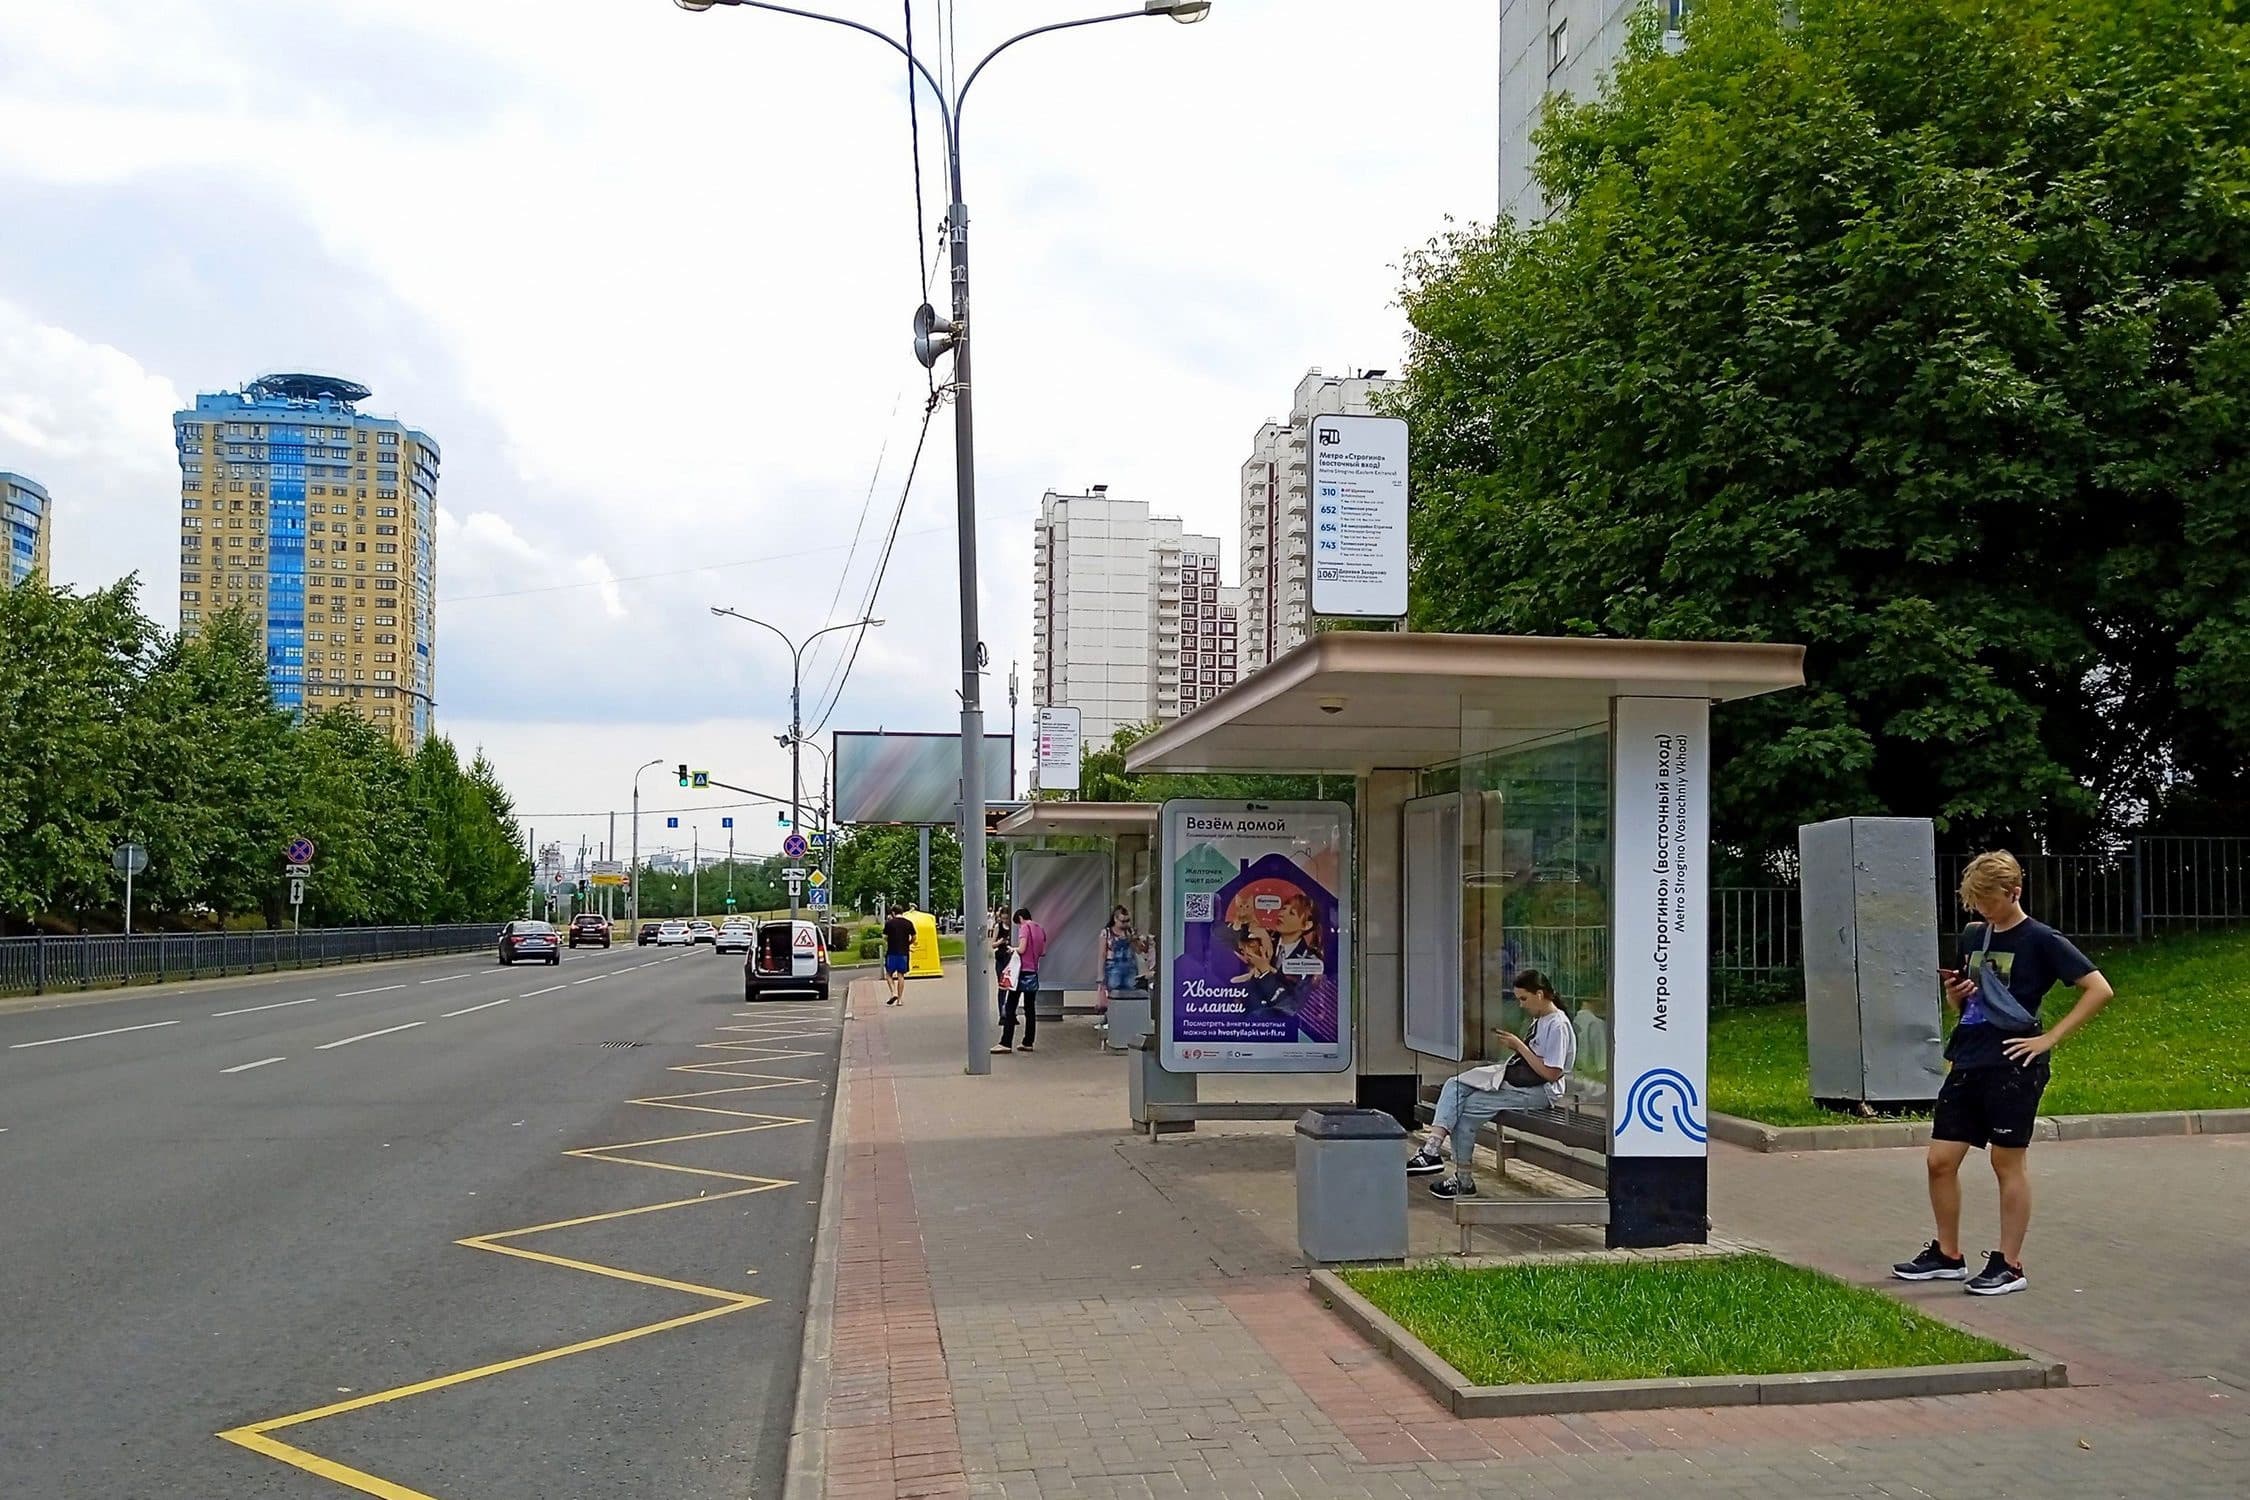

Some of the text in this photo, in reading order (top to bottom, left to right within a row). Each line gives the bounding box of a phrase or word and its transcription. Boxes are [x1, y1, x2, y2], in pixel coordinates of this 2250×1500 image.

[1319, 452, 1343, 460] Метро
[1322, 488, 1336, 496] 310
[1321, 506, 1336, 514] 652
[1321, 524, 1336, 532] 654
[1320, 541, 1336, 550] 743
[1318, 570, 1337, 578] 1067
[1187, 817, 1285, 832] Везём домой
[1674, 735, 1688, 932] Metro Strogino (Vostochniy Vkhod)
[1653, 734, 1672, 1032] Метро «Строгино» (восточный вход)
[1182, 979, 1249, 997] Хвосты
[1186, 1003, 1246, 1013] и лапки
[1183, 1020, 1225, 1028] Посмотреть
